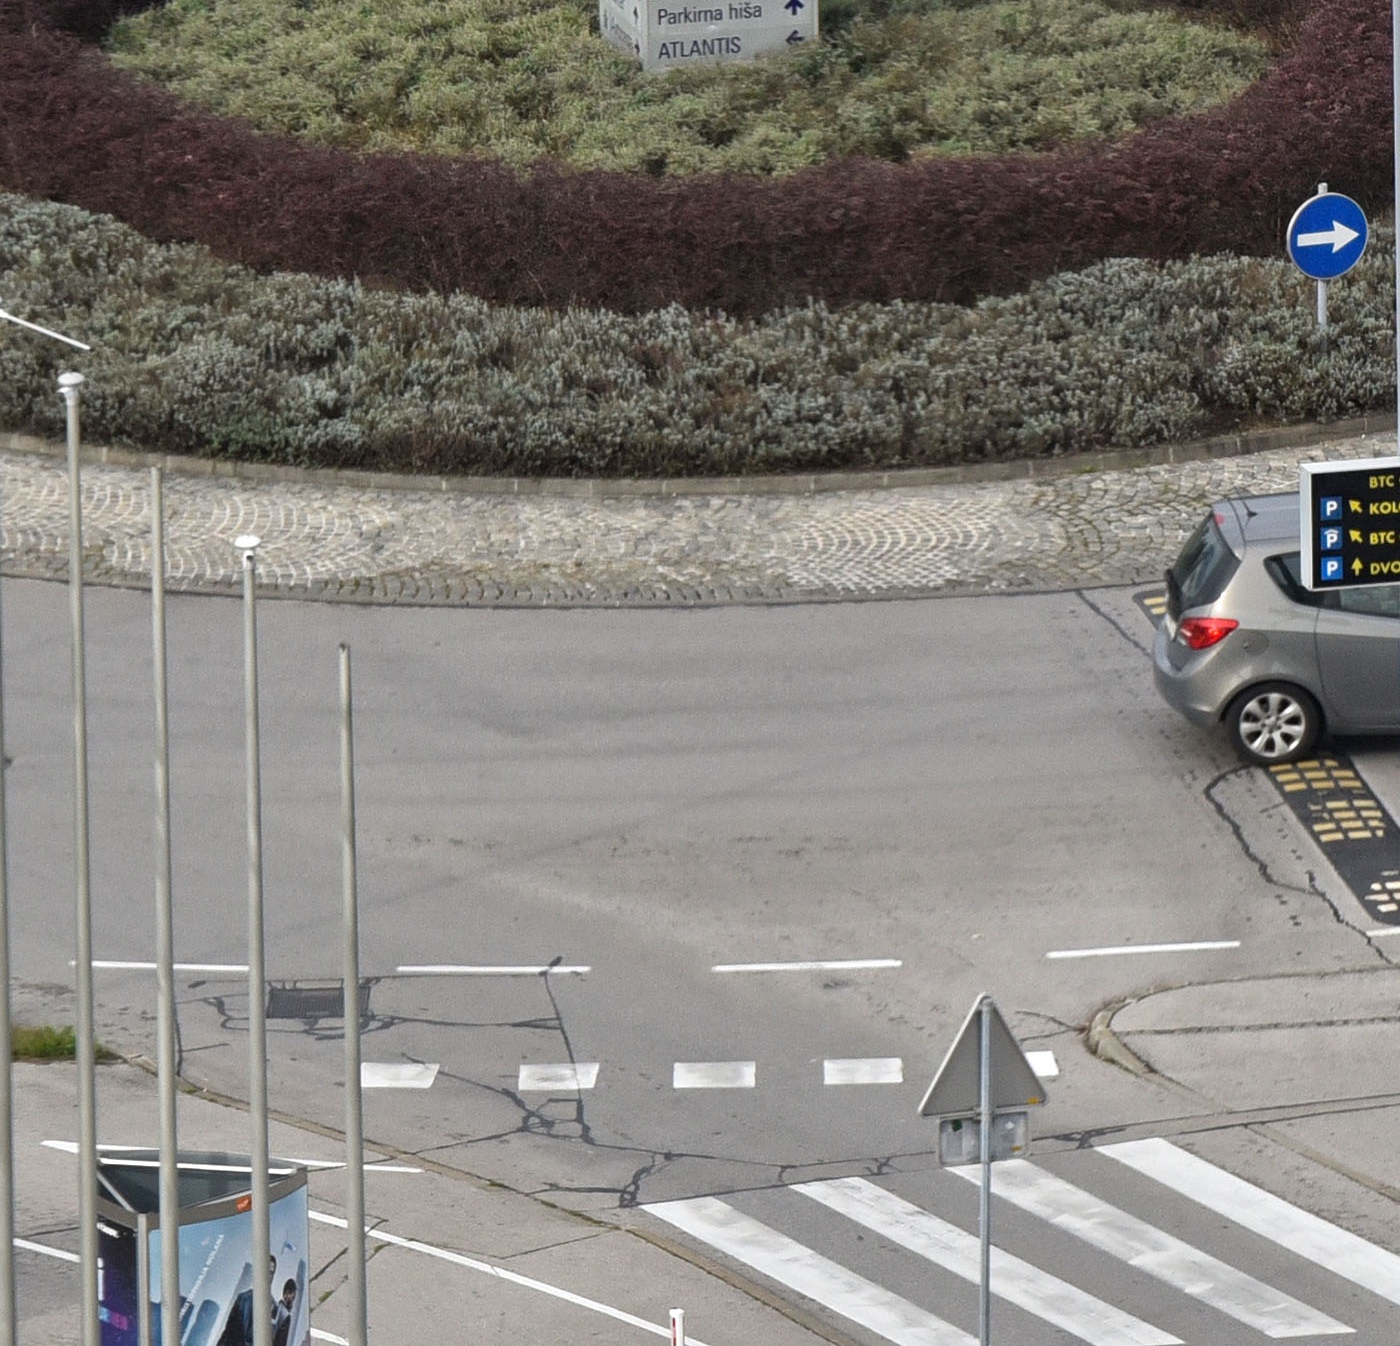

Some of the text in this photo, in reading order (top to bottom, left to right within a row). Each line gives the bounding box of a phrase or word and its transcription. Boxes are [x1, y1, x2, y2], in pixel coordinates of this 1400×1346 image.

[657, 1, 762, 26] Parkirna hiša
[658, 36, 742, 60] ATLANTIS
[1369, 475, 1394, 489] BTC
[1369, 531, 1395, 545] BTC
